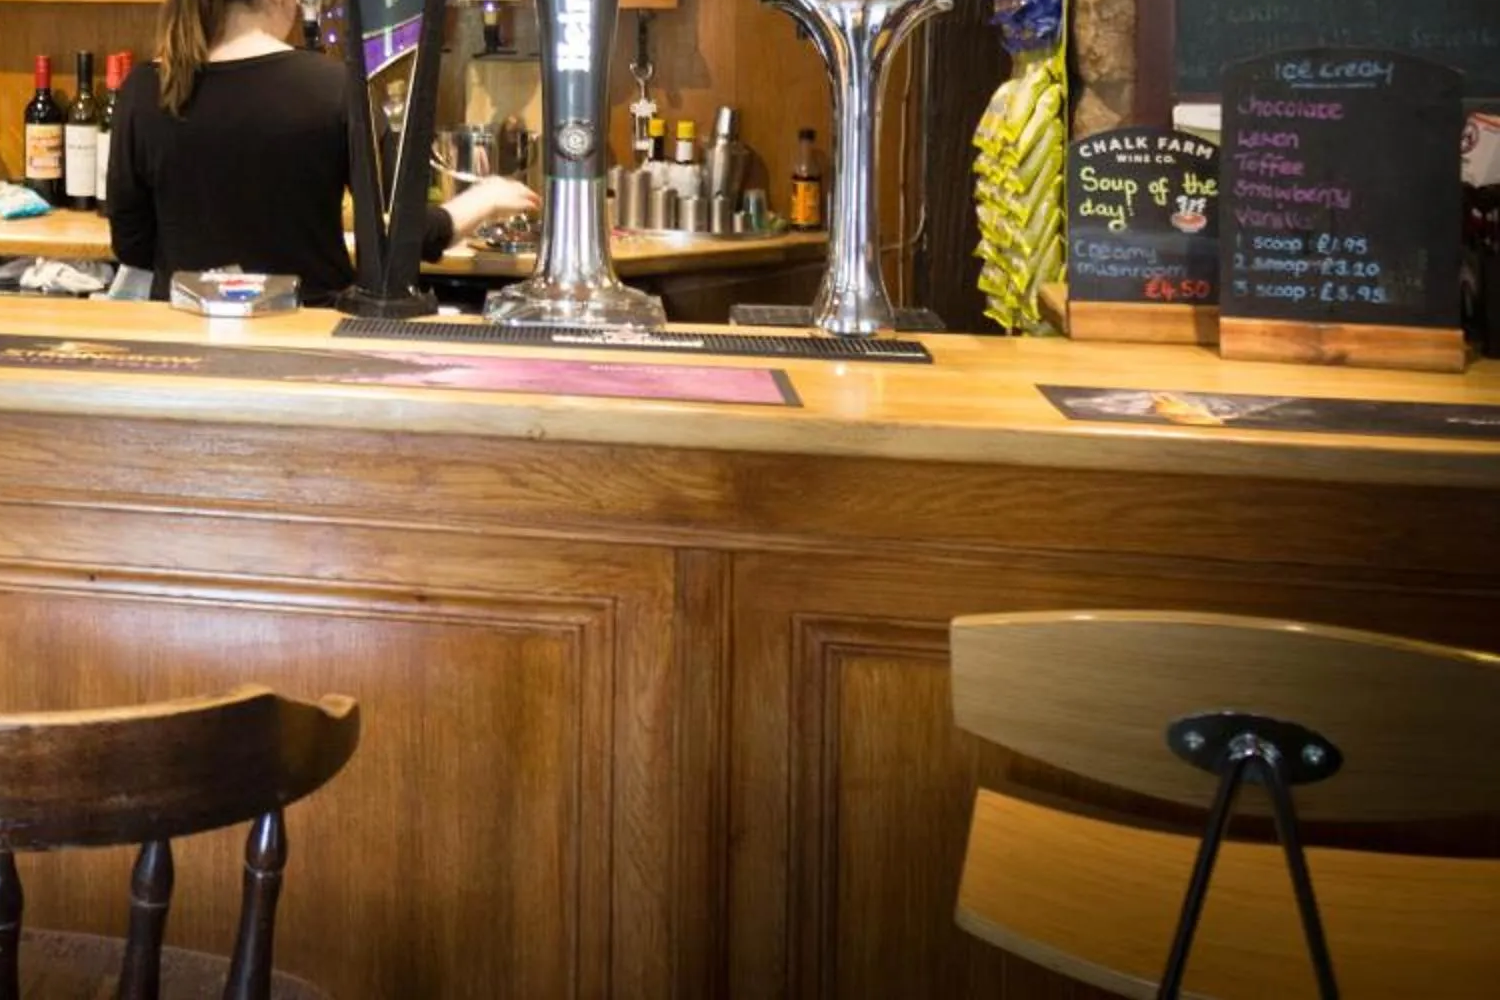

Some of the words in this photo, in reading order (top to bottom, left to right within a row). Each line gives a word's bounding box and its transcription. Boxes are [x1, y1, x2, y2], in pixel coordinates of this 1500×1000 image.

[1078, 135, 1149, 157] CHALK
[1156, 136, 1214, 160] FARM
[1115, 153, 1151, 164] WINE
[1079, 165, 1139, 207] Soup
[1148, 175, 1170, 206] of
[1181, 171, 1219, 196] the
